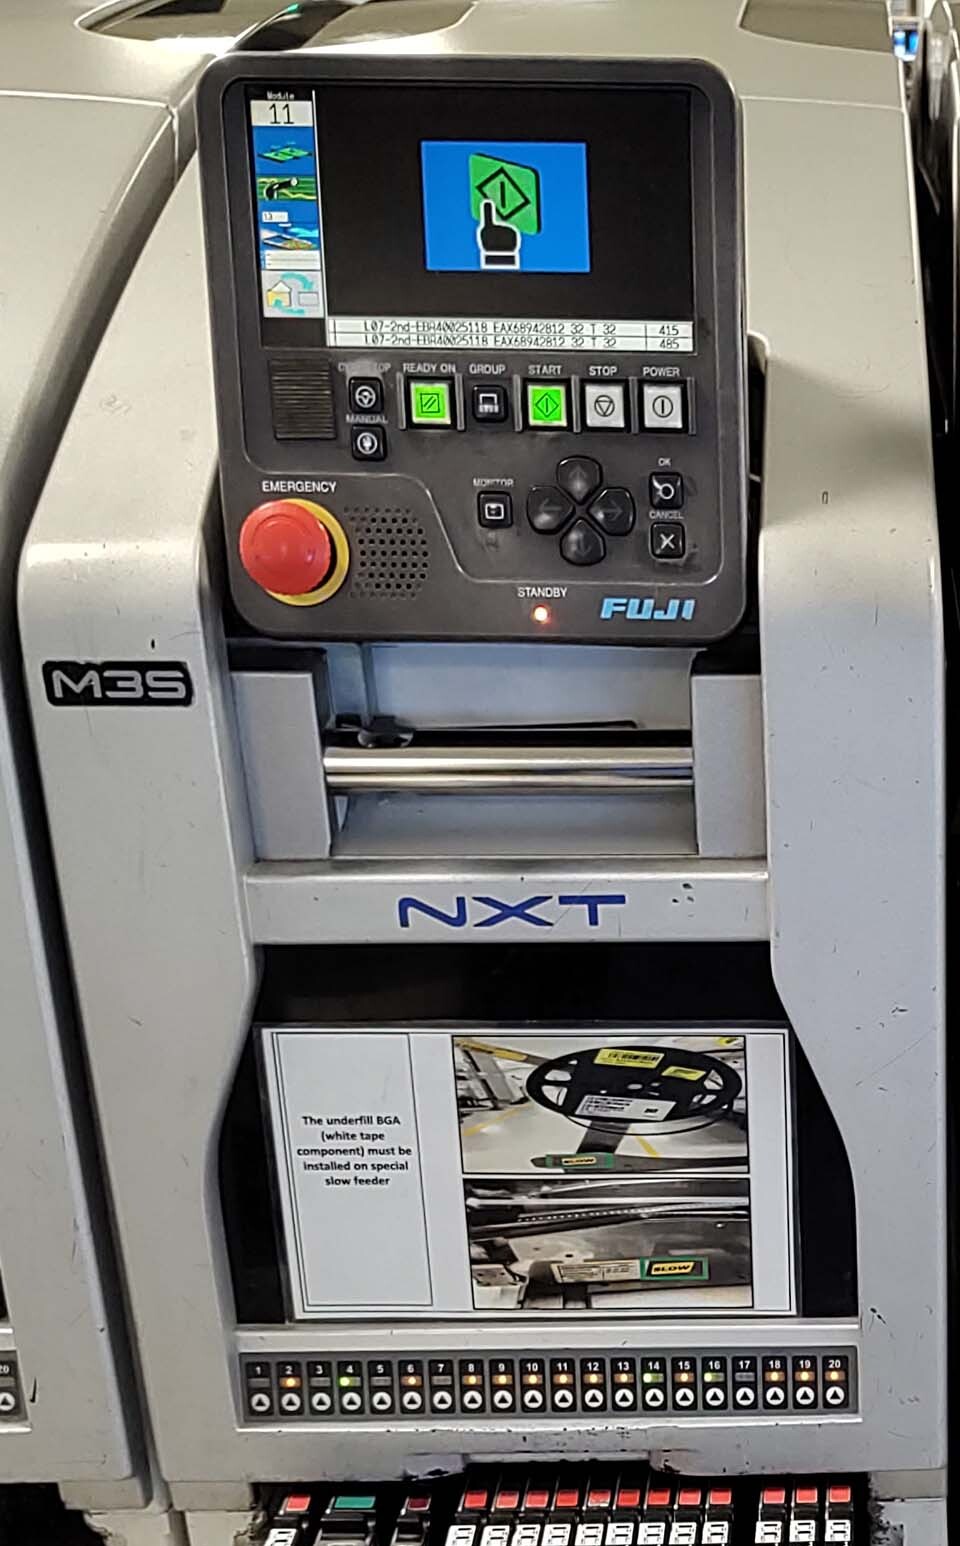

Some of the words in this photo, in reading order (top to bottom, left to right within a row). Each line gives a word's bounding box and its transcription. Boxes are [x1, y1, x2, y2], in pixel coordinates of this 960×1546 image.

[267, 91, 294, 99] Module
[269, 103, 294, 124] 11
[570, 324, 584, 335] 32
[602, 324, 616, 336] 32
[658, 326, 679, 336] 415
[659, 340, 680, 350] 485
[403, 363, 436, 374] READY
[440, 363, 456, 374] ON
[469, 363, 506, 375] GROUP
[528, 364, 562, 376] START
[589, 366, 618, 377] STOP
[643, 367, 681, 378] POWER
[346, 414, 388, 424] MANUAL
[658, 458, 671, 467] OK
[262, 480, 337, 493] EMERGENCY
[649, 511, 684, 520] CANCEL
[517, 587, 568, 598] STANDBY
[600, 598, 696, 620] FUJI
[52, 670, 187, 698] M3S
[399, 894, 626, 928] NXT
[302, 1116, 323, 1125] The
[326, 1116, 373, 1125] underfill
[377, 1116, 400, 1125] BGA
[321, 1131, 356, 1142] (white
[360, 1132, 384, 1141] tape
[297, 1146, 364, 1157] component)
[368, 1147, 395, 1155] must
[399, 1147, 412, 1155] be
[304, 1161, 350, 1171] installed
[371, 1161, 408, 1172] special
[325, 1177, 350, 1185] slow
[354, 1176, 390, 1185] feeder
[653, 1265, 691, 1273] SLOW
[286, 1366, 292, 1374] 2
[317, 1366, 323, 1374] 3
[347, 1365, 353, 1373] 4
[377, 1365, 383, 1373] 5
[407, 1364, 414, 1373] 6
[438, 1364, 444, 1372] 7
[469, 1364, 474, 1372] 8
[499, 1363, 505, 1372] 9
[527, 1363, 538, 1371] 10
[588, 1362, 599, 1371] 12
[618, 1362, 629, 1370] 13
[648, 1362, 659, 1370] 14
[679, 1361, 690, 1369] 15
[709, 1361, 720, 1369] 16
[769, 1360, 780, 1369] 18
[800, 1360, 810, 1368] 19
[829, 1360, 840, 1368] 20
